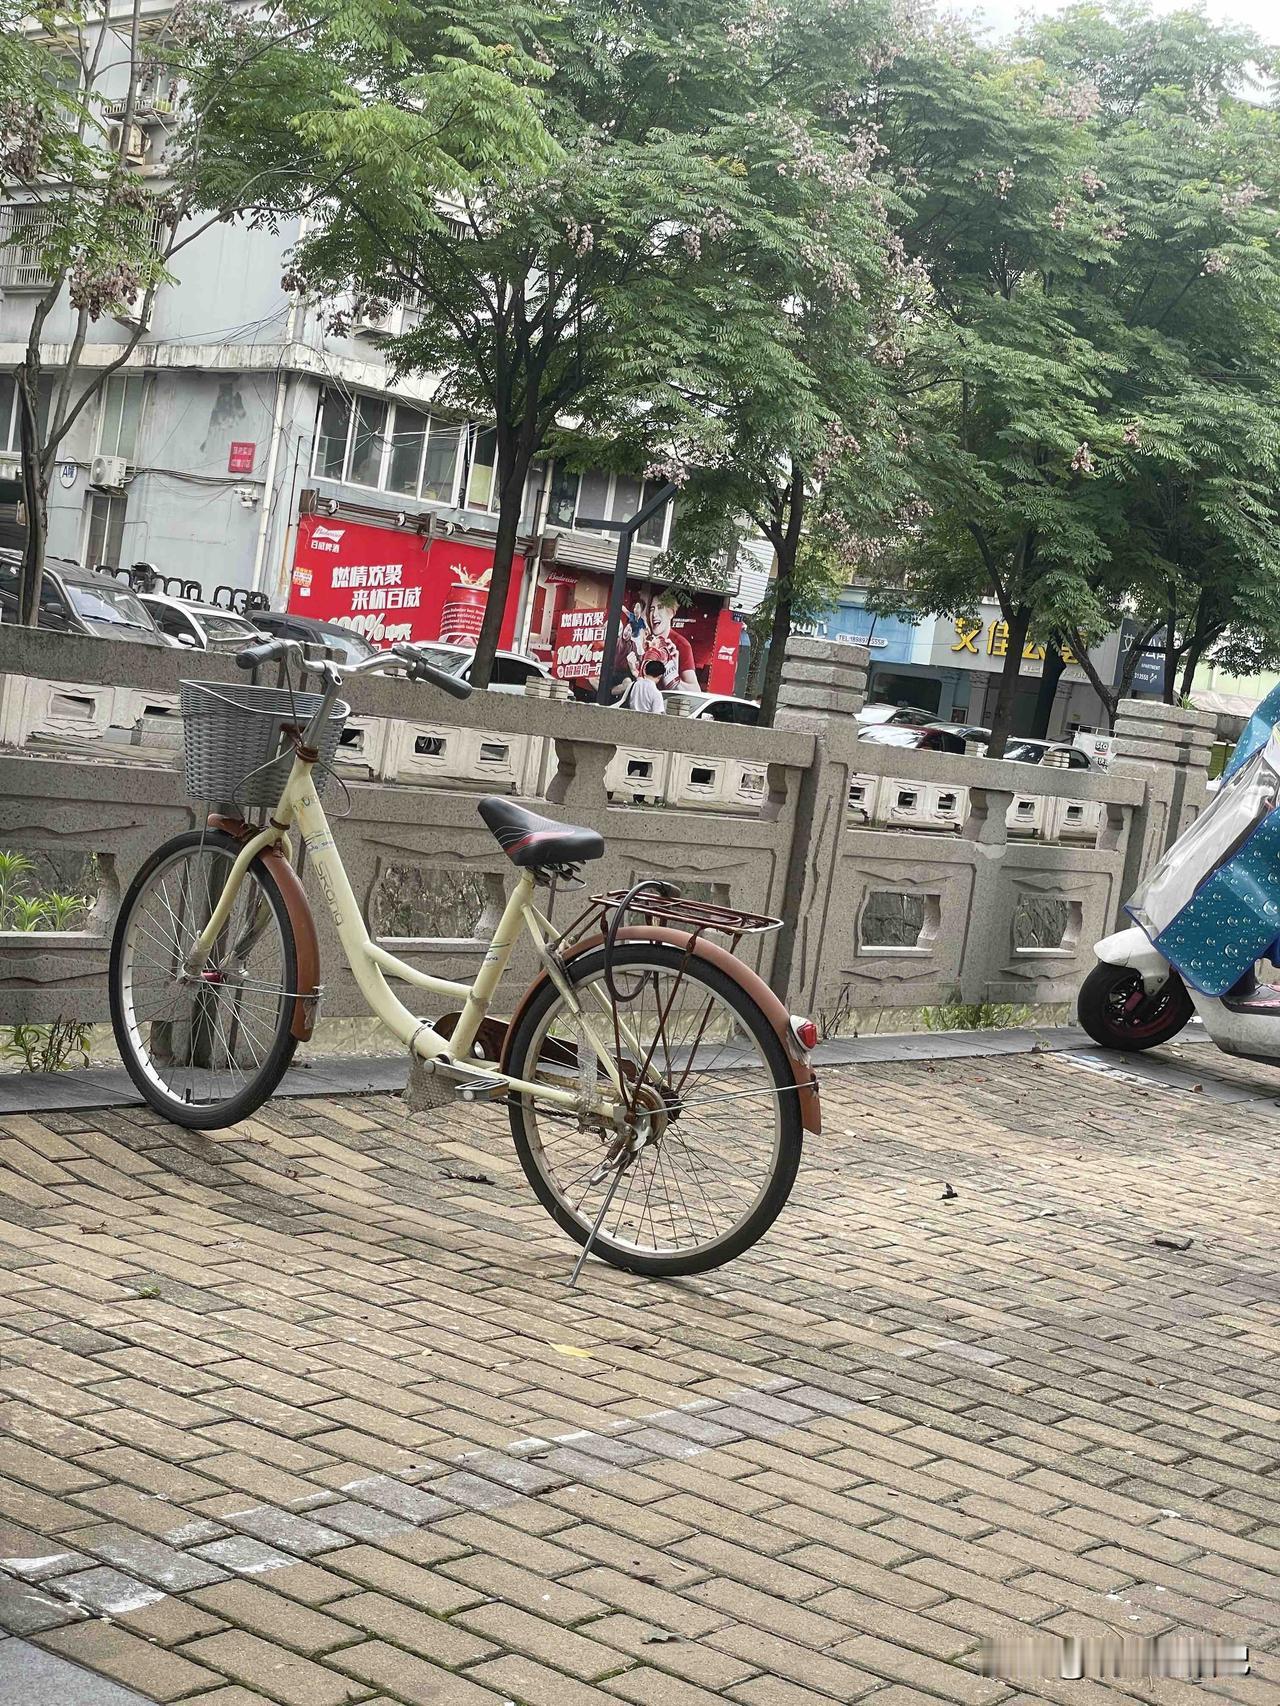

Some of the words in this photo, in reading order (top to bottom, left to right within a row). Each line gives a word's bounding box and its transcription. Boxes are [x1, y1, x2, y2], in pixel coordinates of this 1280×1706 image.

[311, 539, 340, 553] 百威啤酒
[331, 564, 403, 588] 燃情欢聚
[351, 586, 422, 611] 来杯百威
[561, 611, 605, 628] 燃情欢聚
[573, 626, 607, 642] 来杯百
[1095, 741, 1108, 750] sto
